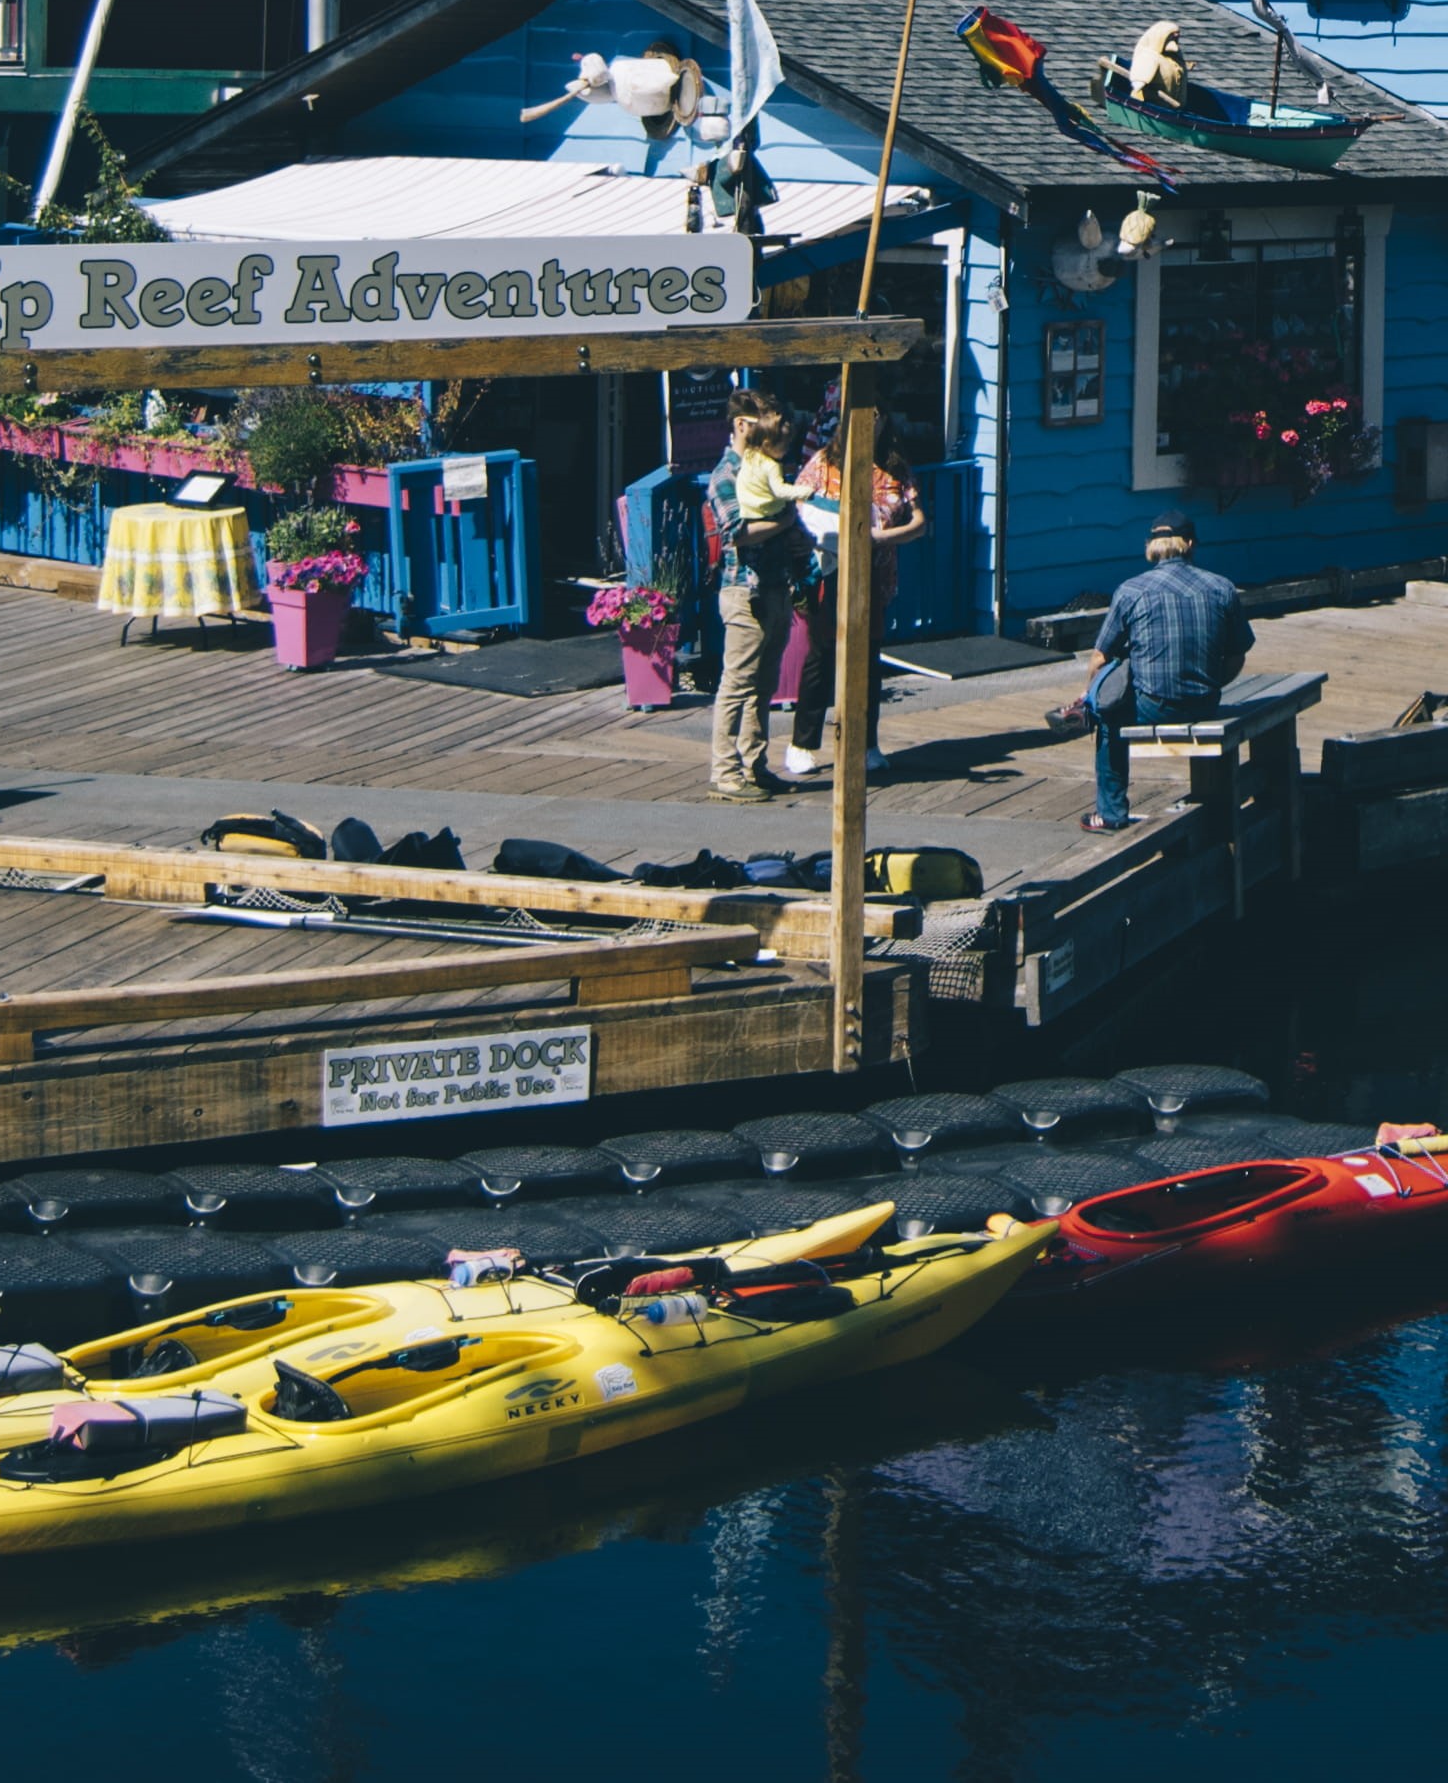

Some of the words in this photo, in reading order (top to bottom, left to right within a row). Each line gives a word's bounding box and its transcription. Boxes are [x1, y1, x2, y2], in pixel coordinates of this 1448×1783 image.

[80, 254, 274, 329] Reef
[284, 251, 728, 323] Adventures
[329, 1047, 481, 1088] PRIVATE
[489, 1036, 587, 1073] DOCK
[359, 1090, 400, 1112] Not
[406, 1087, 439, 1107] for
[444, 1080, 511, 1104] Public
[516, 1075, 556, 1095] Use
[508, 1393, 579, 1419] NECKY
